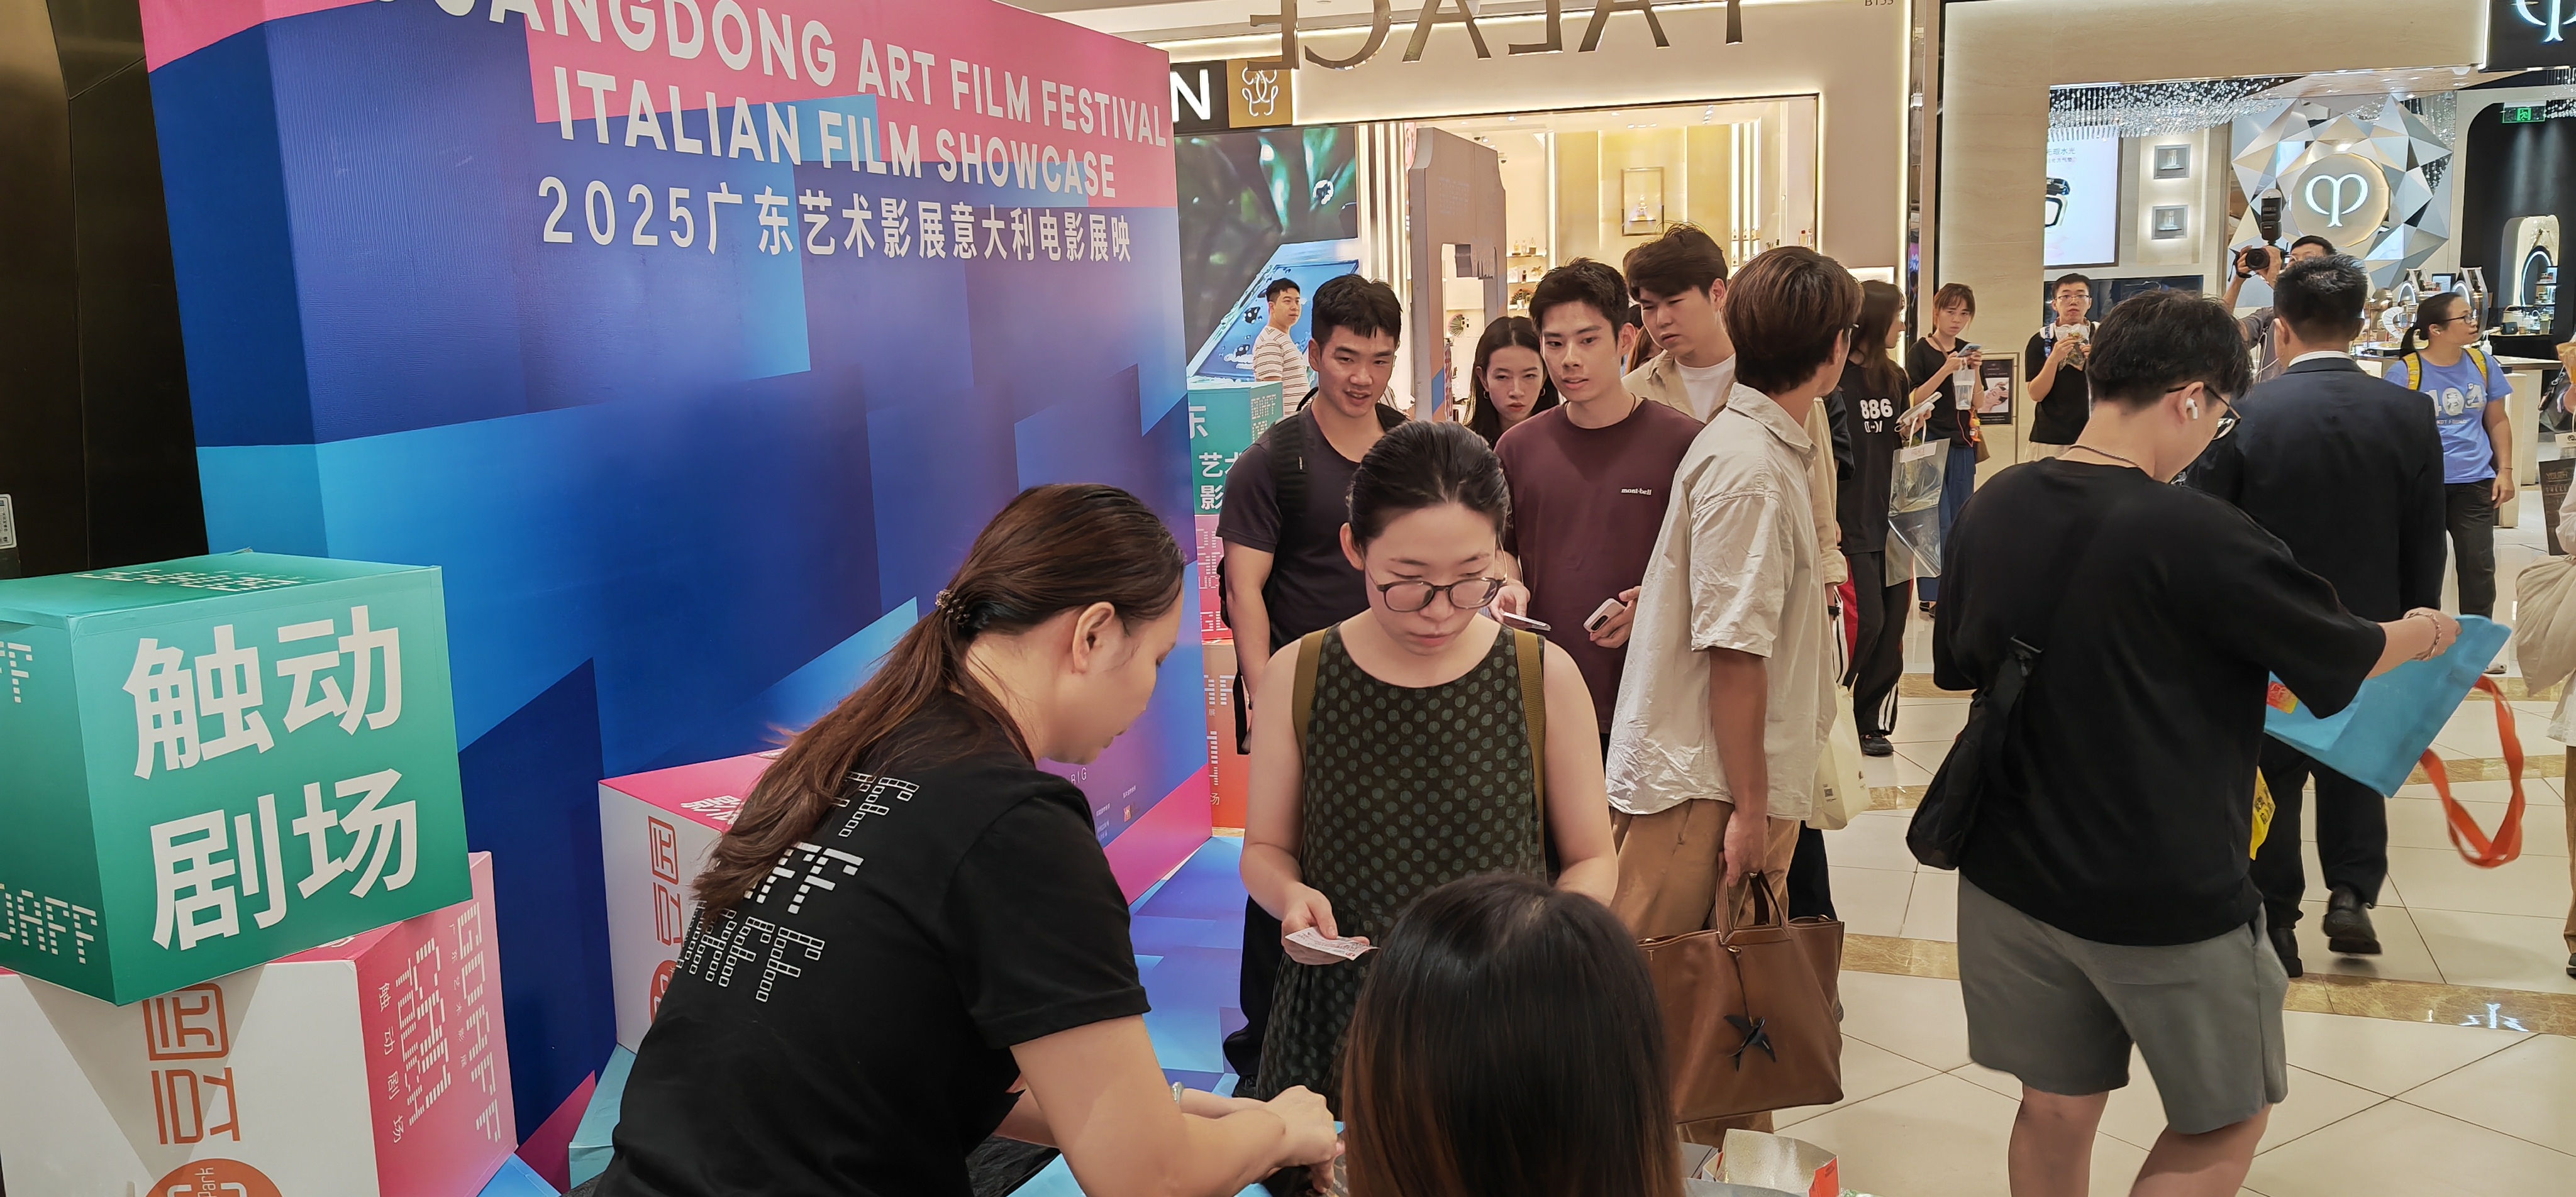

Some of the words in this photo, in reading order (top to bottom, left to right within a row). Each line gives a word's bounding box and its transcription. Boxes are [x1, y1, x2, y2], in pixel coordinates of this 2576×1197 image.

[554, 66, 802, 167] ITALIAN
[818, 109, 922, 179] FILM
[935, 129, 1116, 199] SHOWCASE
[857, 38, 935, 106] ART
[950, 60, 1031, 123] FILM
[1041, 79, 1167, 148] FESTIVAL
[538, 176, 1131, 263] 2025广东艺术影展意大利电影展映
[1860, 399, 1893, 419] 886
[123, 605, 402, 780] 触动
[150, 768, 418, 952] 剧场
[377, 982, 404, 1144] 触动剧场
[395, 957, 426, 1127] TOUCH
[413, 937, 451, 1112] CAN
[457, 902, 501, 1144] GDAFF
